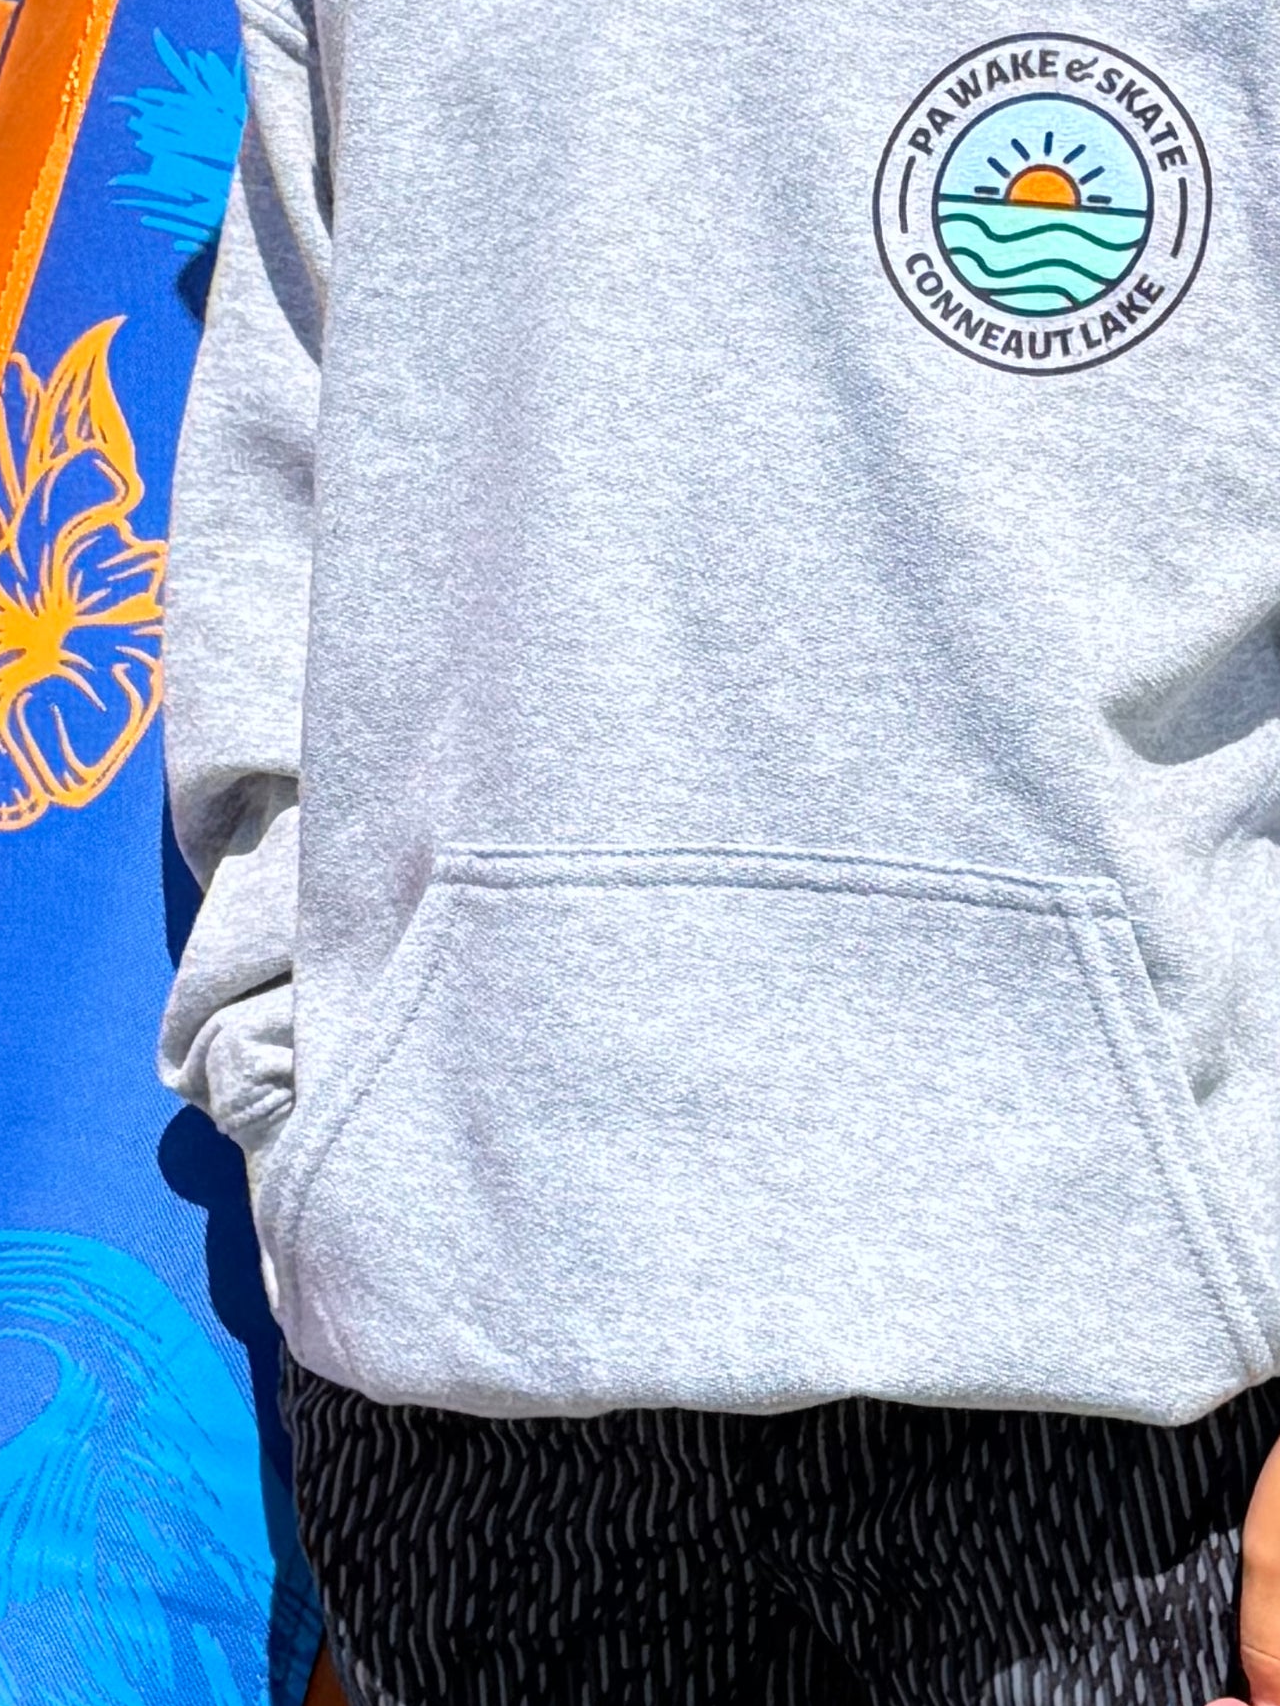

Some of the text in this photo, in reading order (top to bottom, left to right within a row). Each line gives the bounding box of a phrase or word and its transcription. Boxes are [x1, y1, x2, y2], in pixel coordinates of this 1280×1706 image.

[909, 49, 1188, 171] PA WAKE & SKATE
[906, 252, 1165, 360] CONNEAUT LAKE
